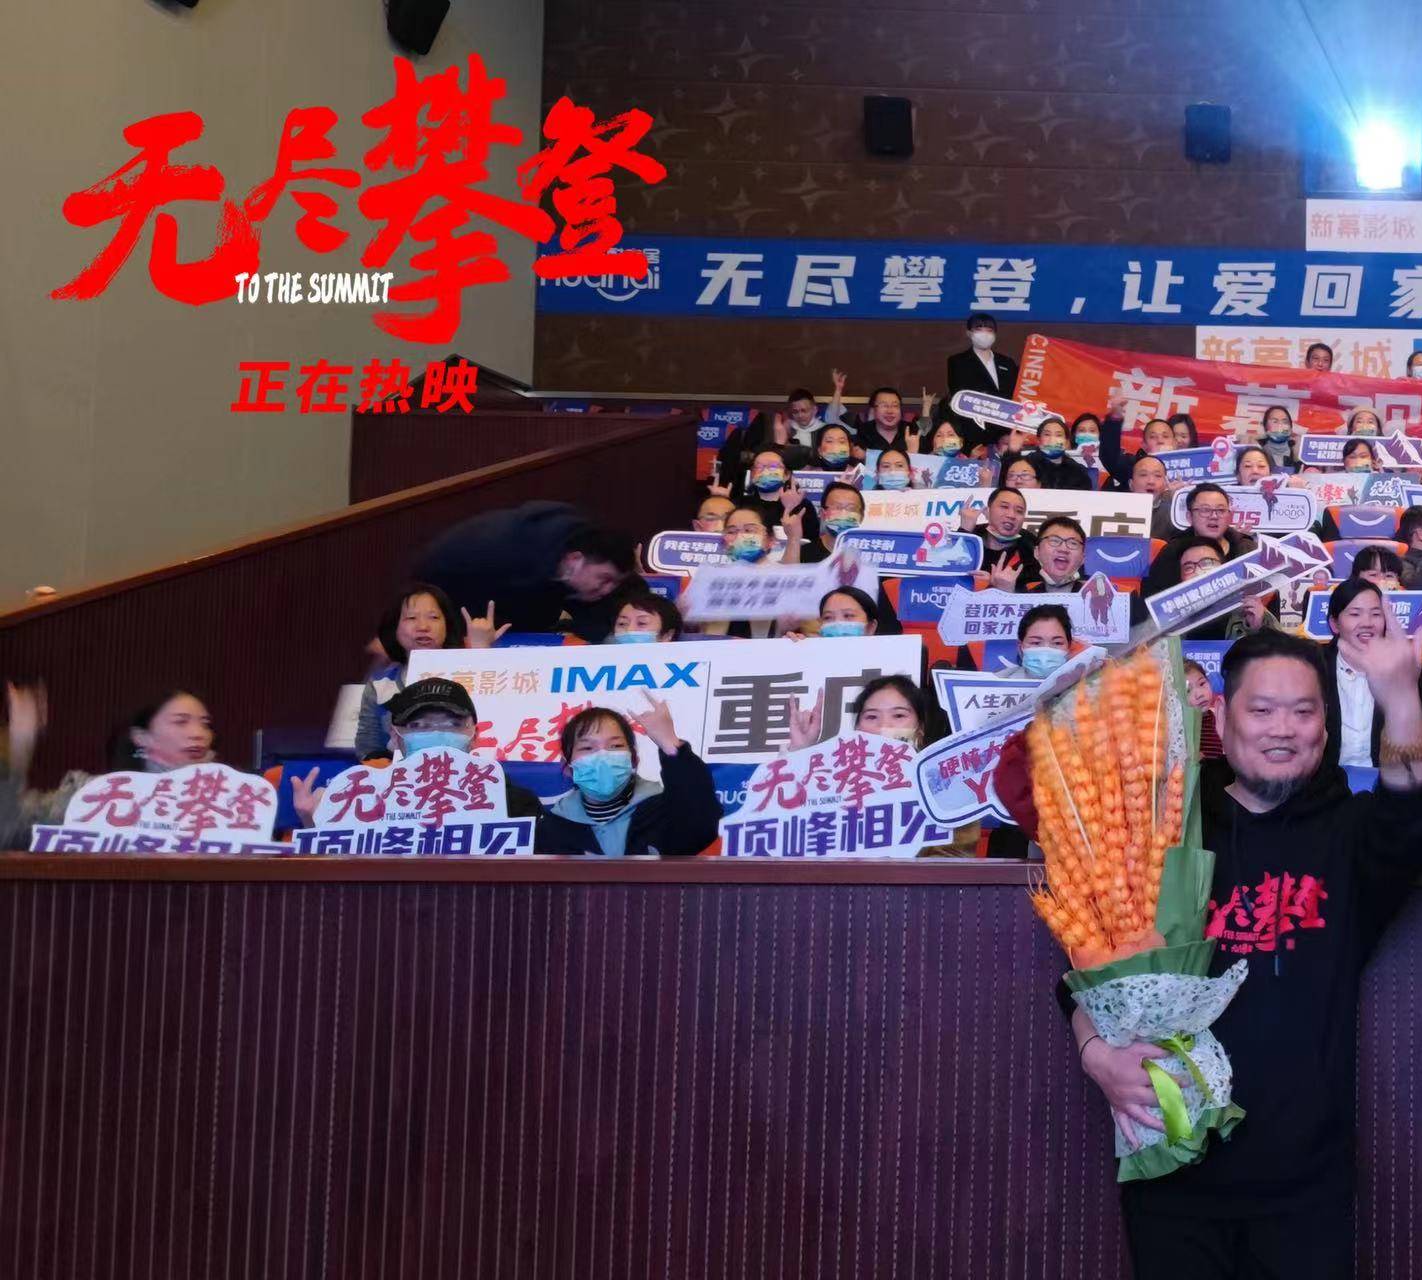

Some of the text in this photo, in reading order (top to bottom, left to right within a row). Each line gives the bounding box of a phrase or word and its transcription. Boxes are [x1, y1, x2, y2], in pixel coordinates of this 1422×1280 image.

[1310, 210, 1415, 240] 新幕影城
[551, 661, 701, 694] IMAX
[81, 768, 272, 841] 无尽攀登
[329, 750, 500, 829] 无尽攀登
[751, 733, 914, 812] 无尽攀登
